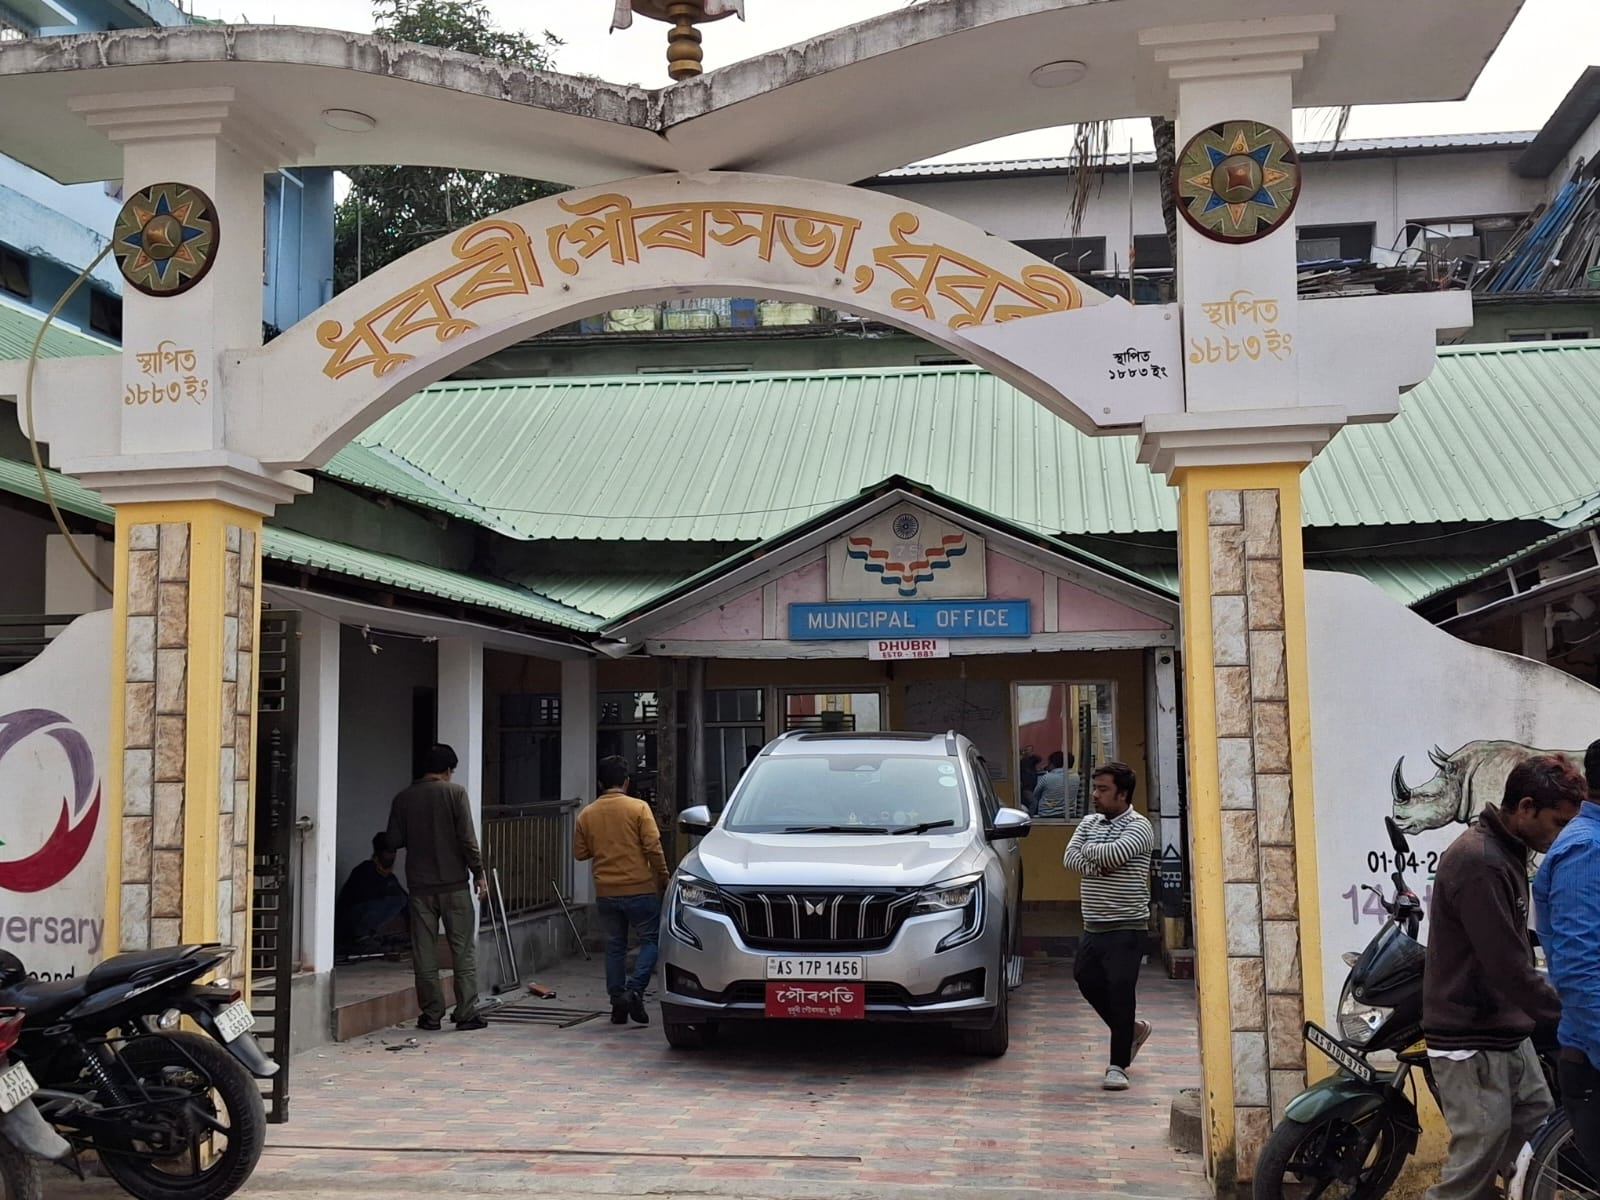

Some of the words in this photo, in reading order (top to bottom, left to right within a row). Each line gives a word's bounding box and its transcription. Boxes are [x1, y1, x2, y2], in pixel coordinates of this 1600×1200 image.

[1201, 289, 1279, 330] স্থাপিত
[136, 339, 197, 378] স্থাপিত
[1112, 347, 1152, 366] স্থাপিত
[808, 610, 916, 629] MUNICIPAL
[936, 608, 1009, 628] OFFICE
[878, 640, 937, 651] DHUBRI
[912, 650, 934, 658] 1883
[777, 960, 792, 976] AS
[797, 960, 822, 976] 17P
[827, 960, 858, 976] 1456
